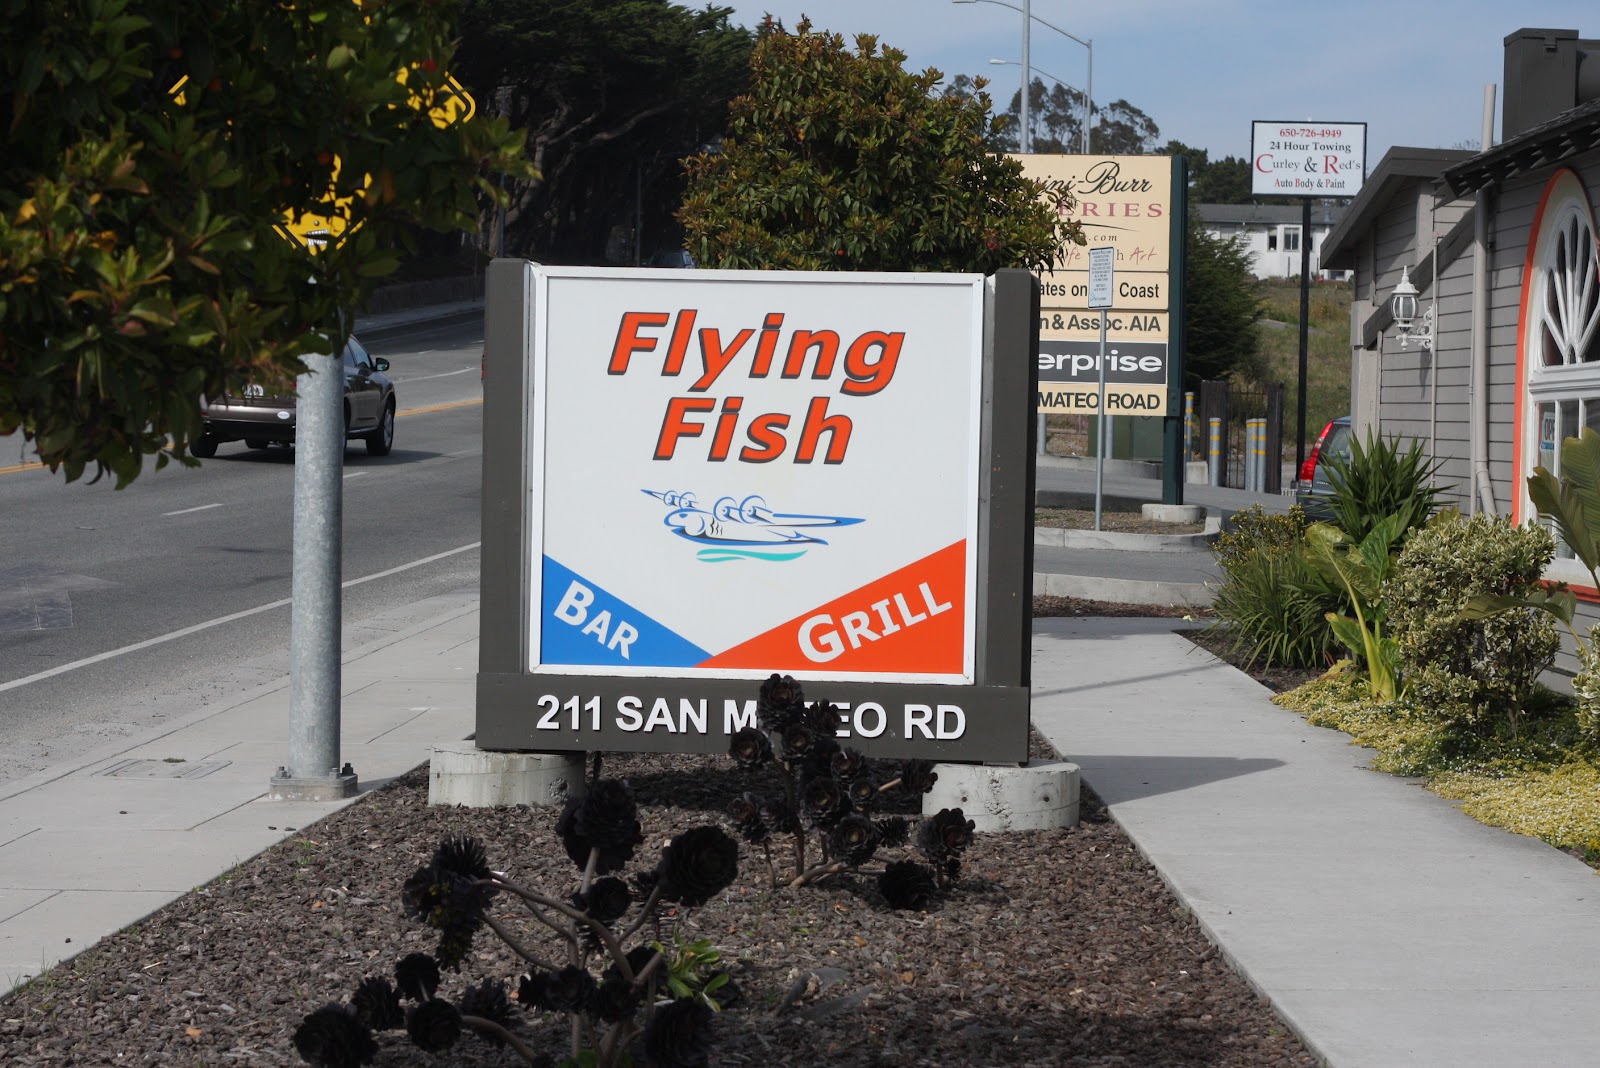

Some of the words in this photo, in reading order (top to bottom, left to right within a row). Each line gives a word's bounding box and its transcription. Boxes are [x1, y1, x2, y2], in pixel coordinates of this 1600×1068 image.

[1279, 128, 1342, 138] 650-726-4949
[1269, 141, 1281, 150] 24
[1284, 142, 1310, 151] Hour
[1312, 142, 1352, 153] Towing
[1256, 154, 1300, 173] Curley
[1304, 156, 1318, 173] &
[1323, 155, 1361, 174] Red's
[1033, 161, 1152, 195] ini-Burr
[1274, 178, 1293, 188] Auto
[1295, 178, 1315, 190] Body
[1316, 179, 1323, 188] &
[1325, 179, 1345, 188] Paint
[1087, 234, 1118, 242] .com
[1129, 246, 1157, 265] Art
[1119, 282, 1160, 298] Coast
[1052, 313, 1065, 330] &
[607, 309, 906, 397] Flying
[1038, 349, 1163, 376] erprise
[1038, 391, 1099, 409] MATEO
[1107, 393, 1161, 410] ROAD
[652, 396, 853, 465] Fish
[553, 580, 639, 660] BAR
[798, 581, 953, 663] GRILL
[536, 694, 602, 731] 211
[615, 695, 708, 735] SAN
[723, 699, 888, 739] MEO
[904, 703, 967, 741] RD
